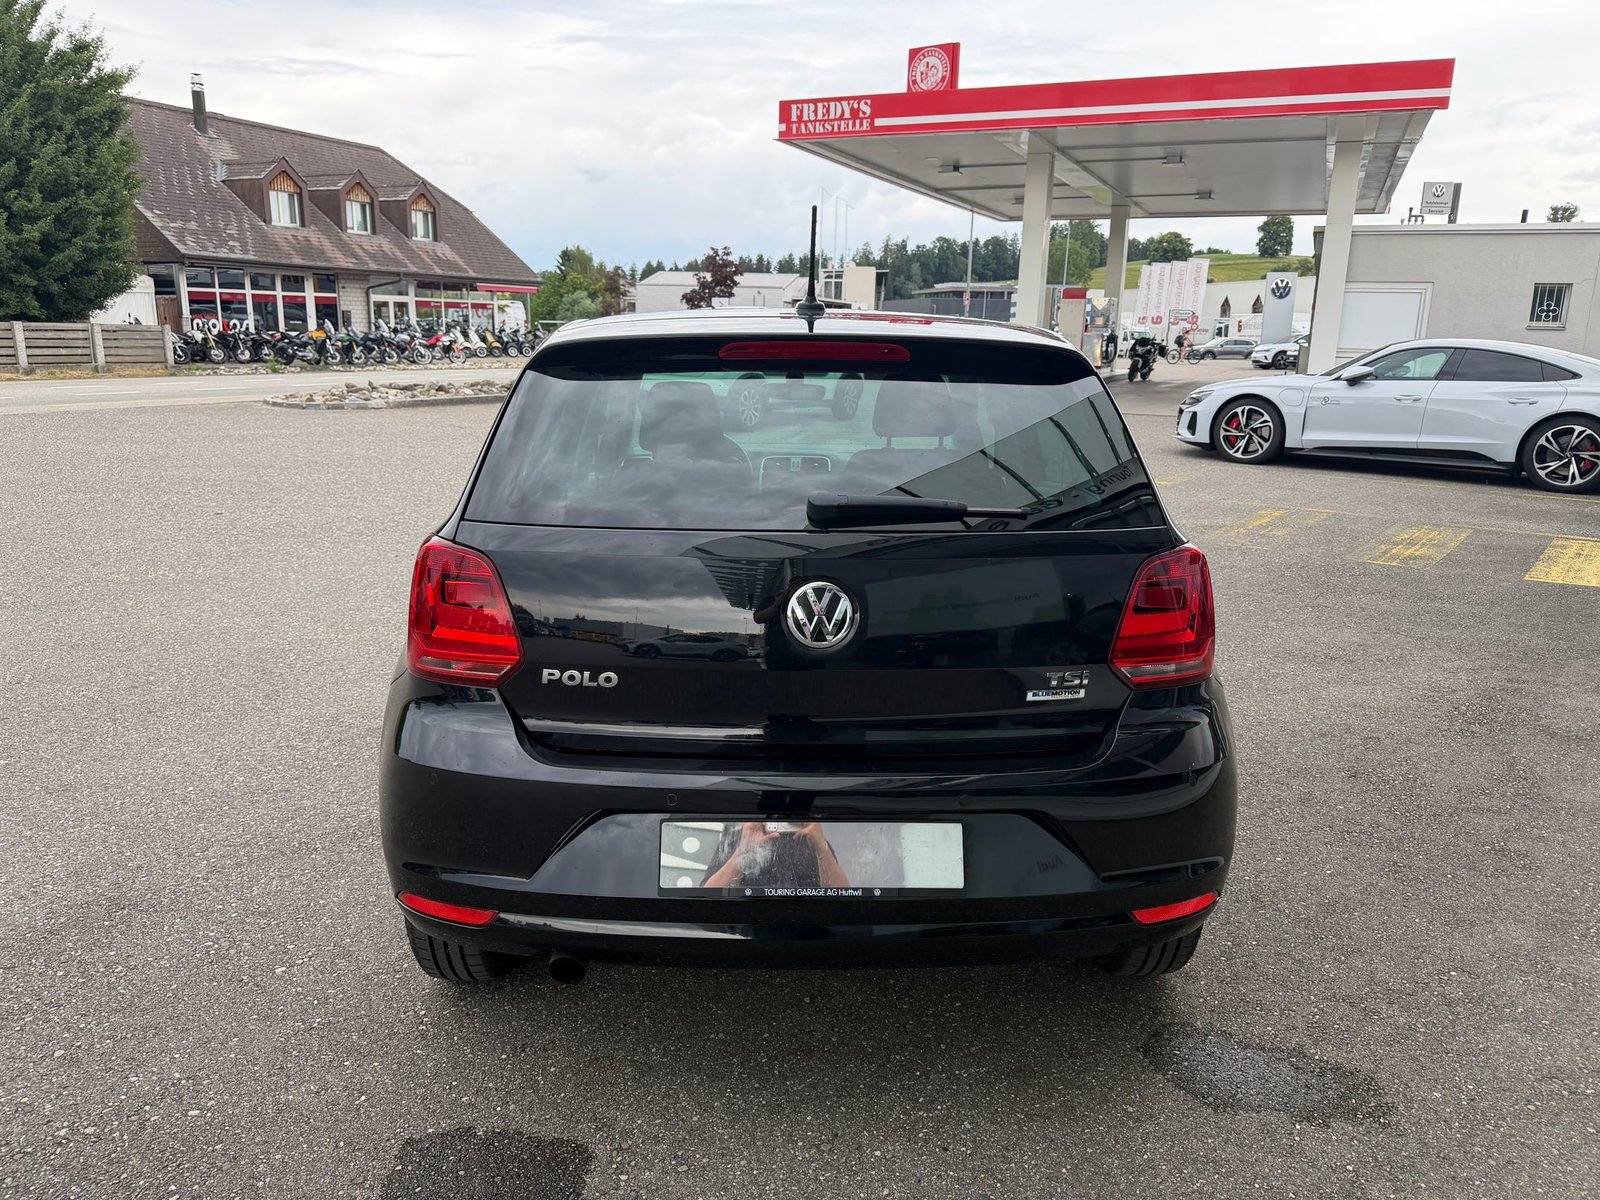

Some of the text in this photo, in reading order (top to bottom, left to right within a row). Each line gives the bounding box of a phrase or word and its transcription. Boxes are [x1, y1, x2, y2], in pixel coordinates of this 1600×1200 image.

[790, 98, 872, 122] FREDY'S
[790, 118, 871, 135] TANKSTELLE
[541, 667, 620, 689] POLO
[1031, 688, 1081, 698] BLUEMOTION
[764, 888, 796, 896] TOURING
[797, 888, 826, 896] GARAGE
[826, 888, 838, 896] AG
[838, 888, 863, 896] Huttwil
